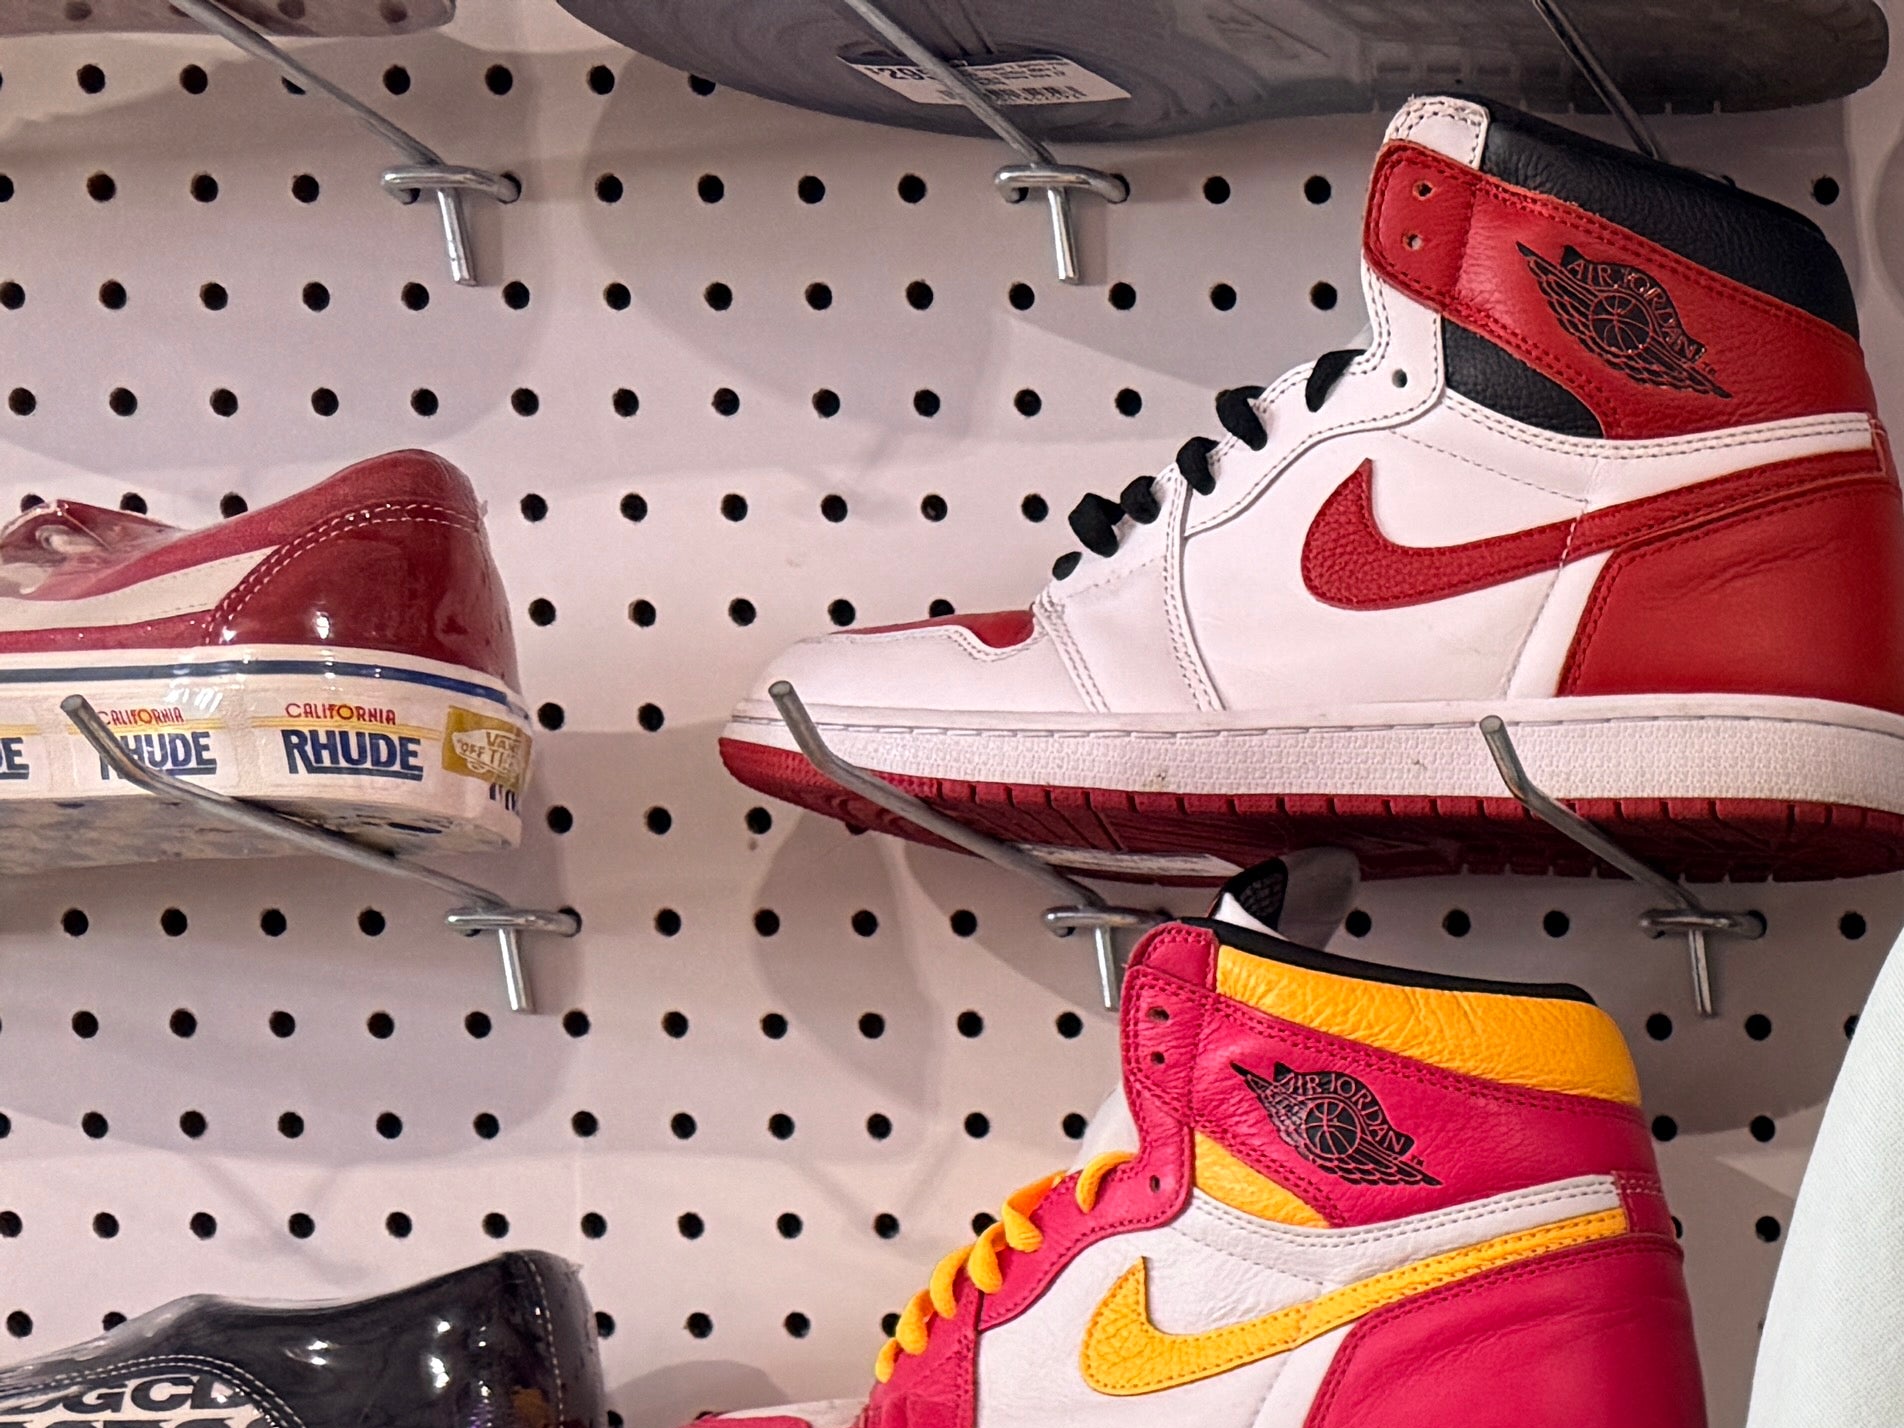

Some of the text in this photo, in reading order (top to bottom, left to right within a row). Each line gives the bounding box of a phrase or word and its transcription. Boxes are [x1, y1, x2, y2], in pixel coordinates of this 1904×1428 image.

[1567, 259, 1699, 359] AIR JORDAN
[285, 702, 396, 725] CALIFORNIA
[281, 729, 424, 782] RHUDE
[1279, 1073, 1406, 1153] AIR JORDAN
